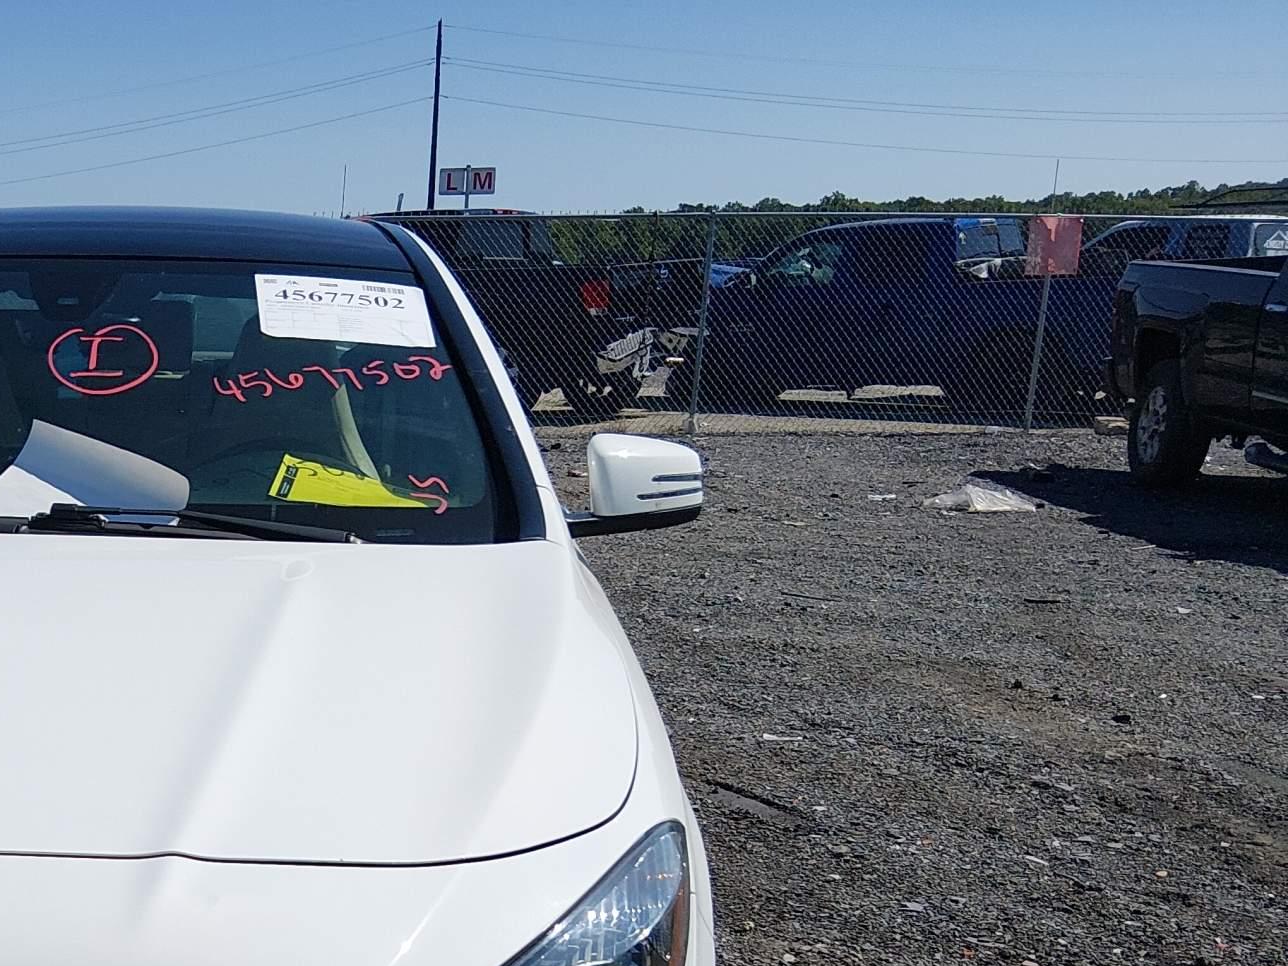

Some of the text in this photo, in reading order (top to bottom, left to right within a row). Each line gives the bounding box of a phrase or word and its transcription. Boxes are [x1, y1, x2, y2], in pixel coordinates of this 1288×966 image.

[446, 171, 493, 191] L M
[274, 288, 406, 310] 45677502
[212, 355, 453, 403] 45677502
